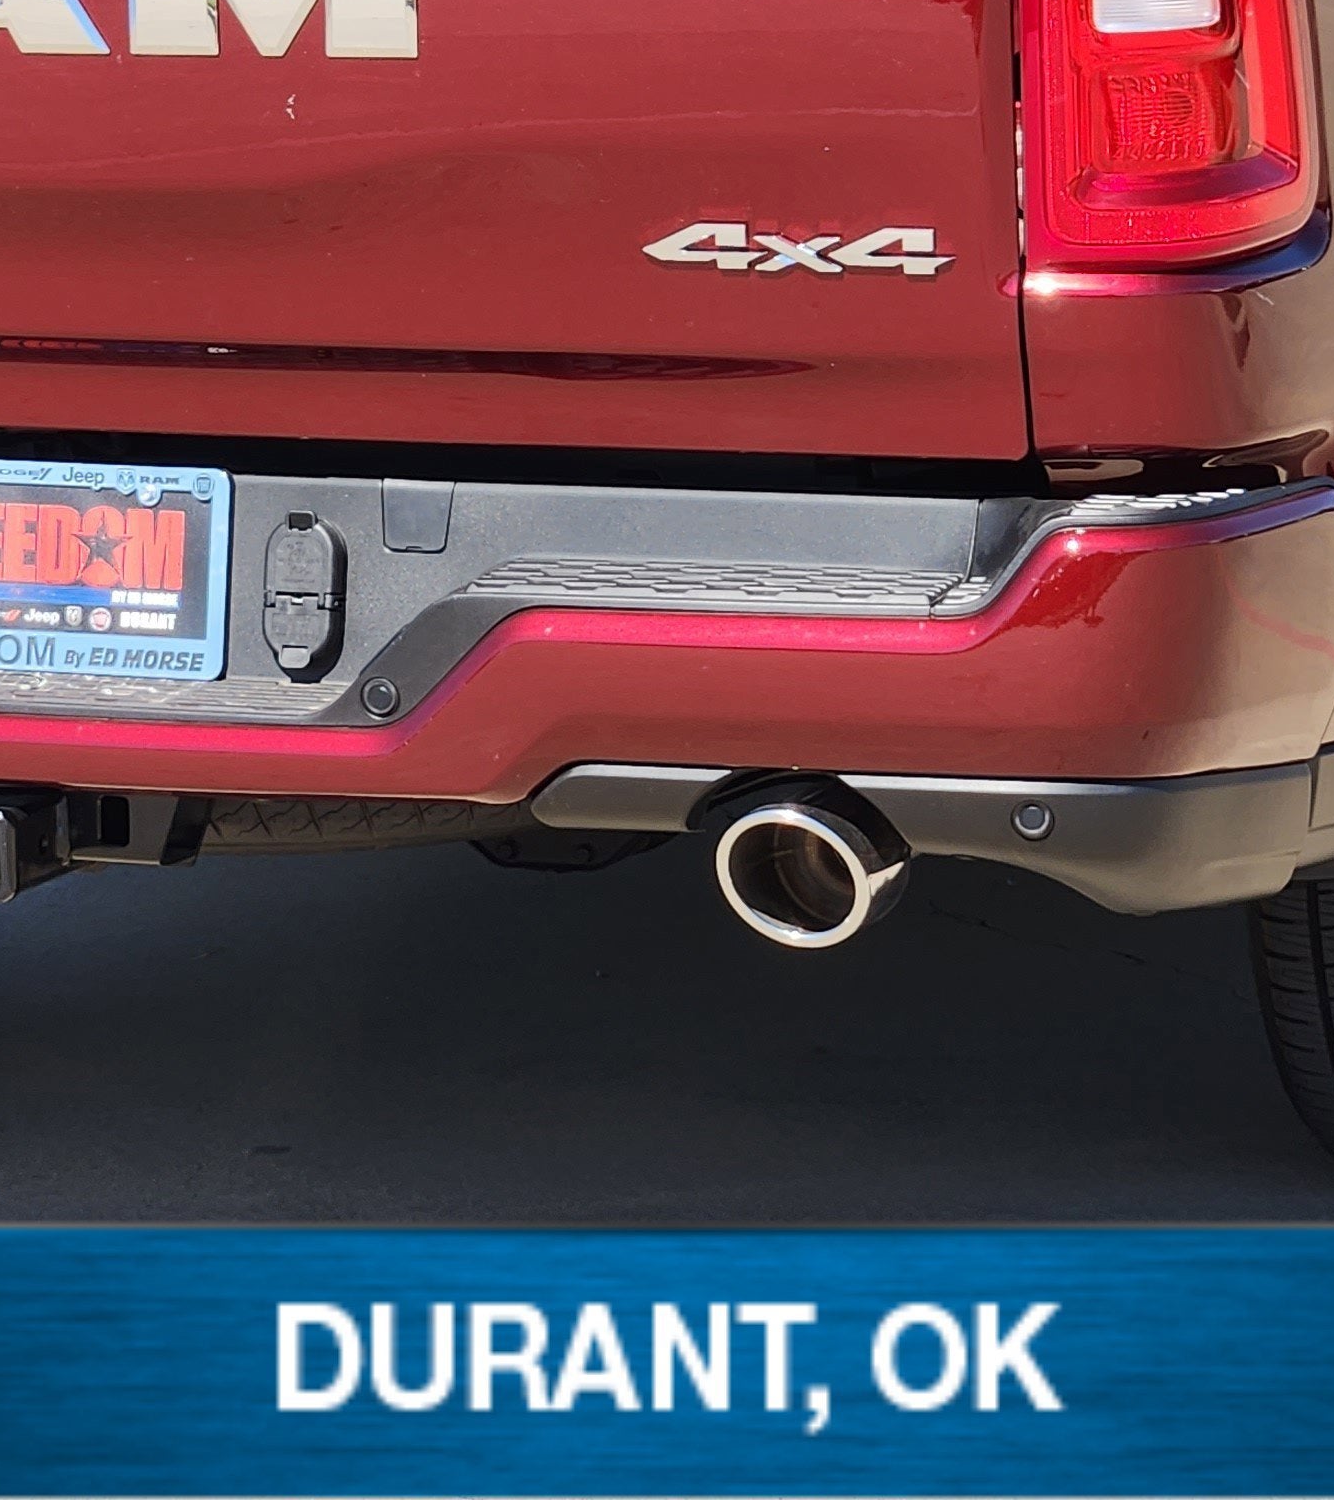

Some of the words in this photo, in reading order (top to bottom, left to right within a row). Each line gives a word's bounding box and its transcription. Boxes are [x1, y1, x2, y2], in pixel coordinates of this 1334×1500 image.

[642, 222, 957, 275] 4x4
[62, 466, 105, 485] Jeep
[140, 475, 180, 485] RAM
[23, 608, 60, 626] Jeep
[64, 649, 85, 668] By
[88, 646, 116, 667] ED
[121, 648, 205, 672] MORSE
